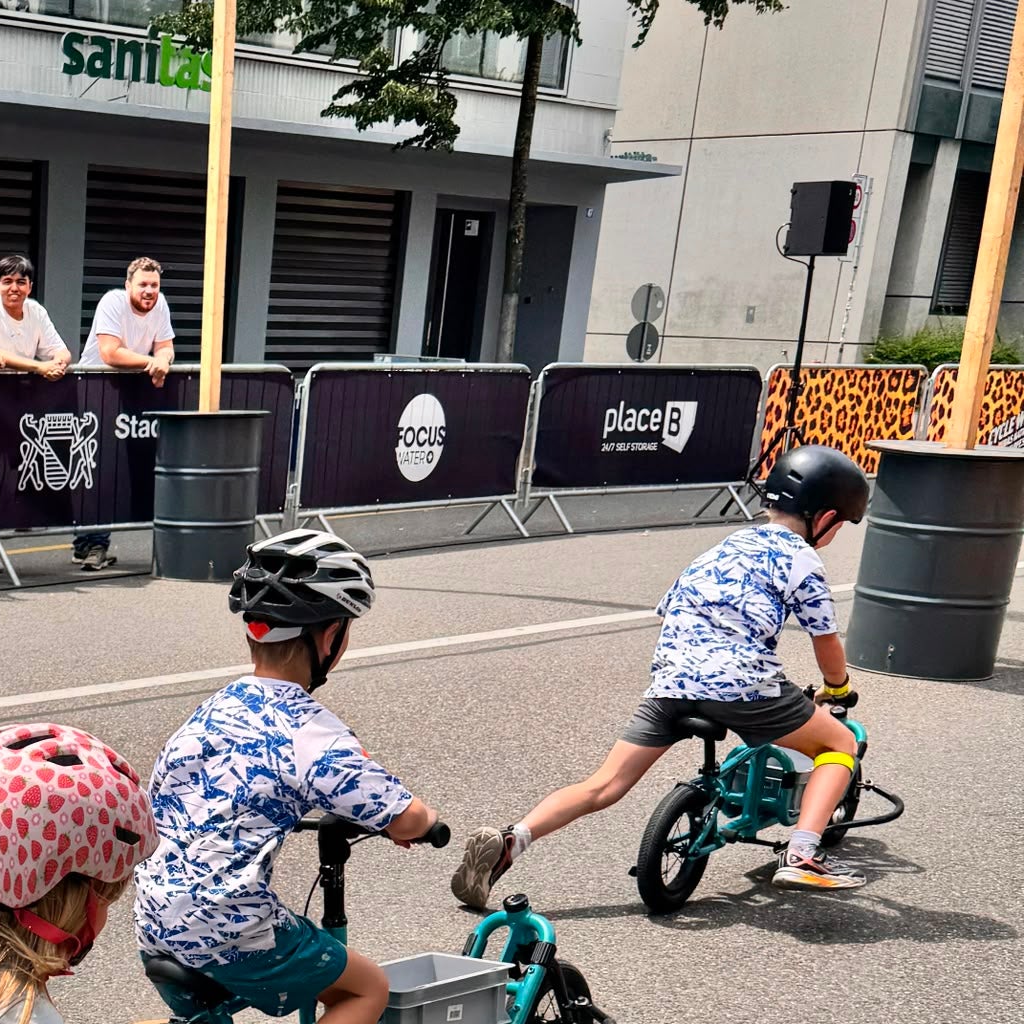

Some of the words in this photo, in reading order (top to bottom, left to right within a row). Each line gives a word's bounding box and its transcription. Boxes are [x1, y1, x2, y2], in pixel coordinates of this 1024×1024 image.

[396, 426, 447, 448] FOCUS
[601, 443, 615, 452] 24/7
[615, 442, 630, 451] SELF
[630, 442, 658, 451] STORAGE
